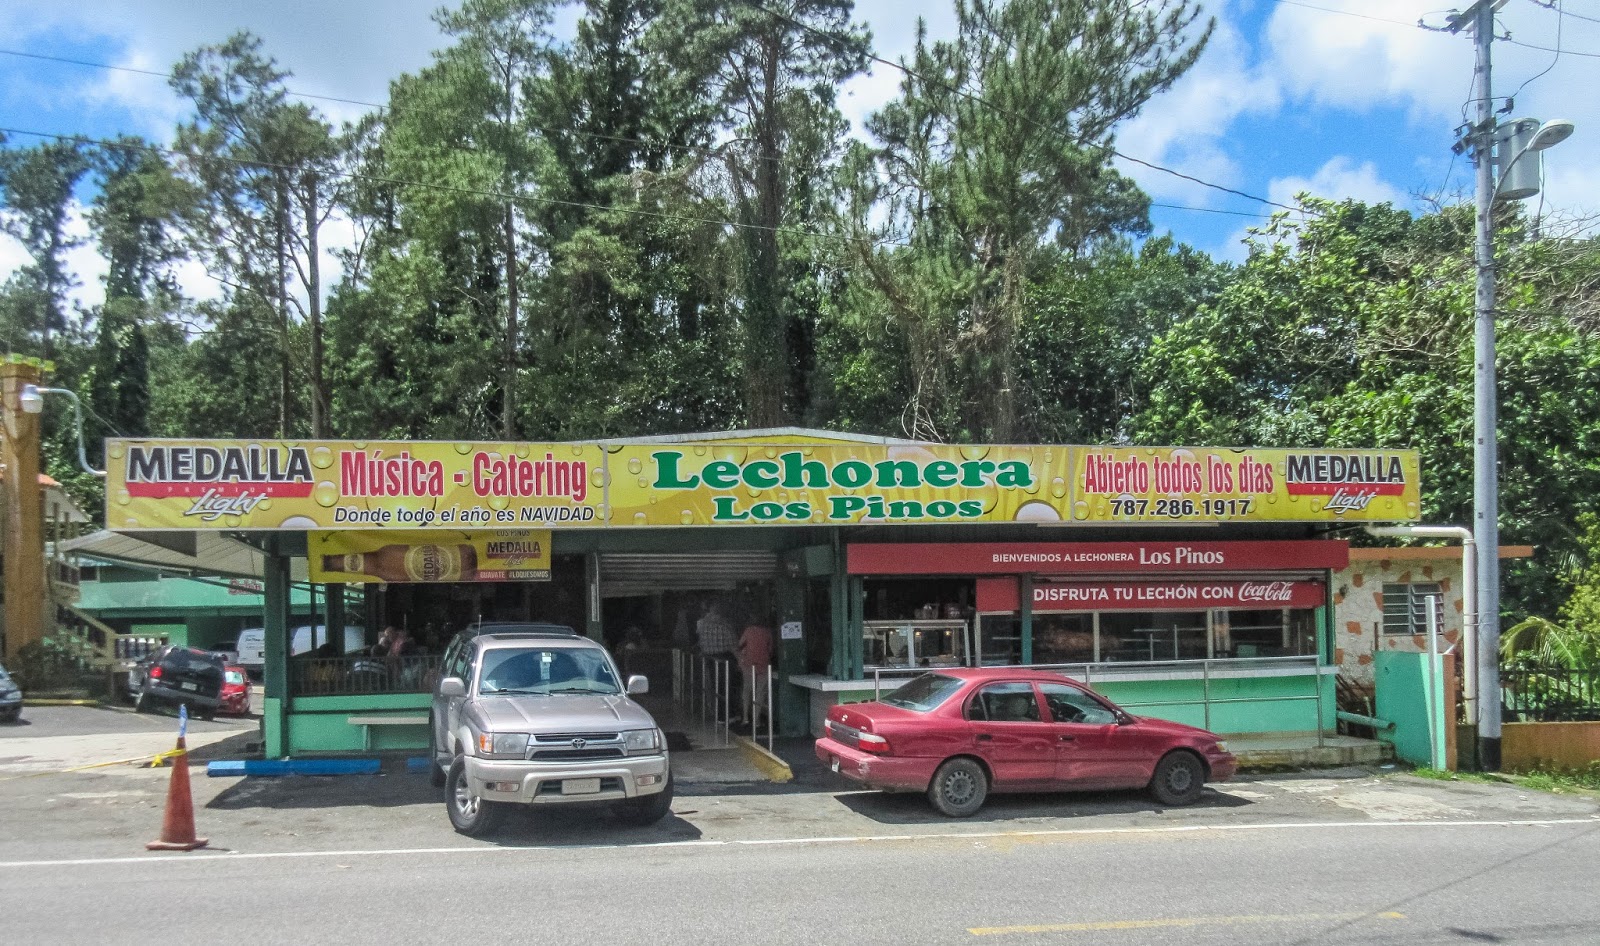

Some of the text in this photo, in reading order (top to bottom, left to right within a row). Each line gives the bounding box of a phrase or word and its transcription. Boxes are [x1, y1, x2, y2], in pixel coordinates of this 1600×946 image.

[127, 446, 315, 483] MEDALLA
[340, 450, 444, 497] Música
[473, 451, 588, 502] Catering
[651, 451, 1033, 489] Lechonera
[1085, 454, 1149, 494] Abierto
[1153, 456, 1202, 494] todos
[1207, 455, 1233, 493] los
[1287, 454, 1405, 483] MEDALLA
[167, 486, 274, 494] PREMIUM
[1322, 487, 1378, 514] Light
[183, 488, 269, 521] Light
[335, 506, 594, 523] Donde todo el año es NAVIDAD
[712, 496, 984, 520] Los Pinos
[1110, 499, 1251, 516] 787.286.1917
[487, 541, 541, 553] MEDALLA
[992, 547, 1225, 565] BIENVENIDOS A LECHONERA Los Pinos
[1033, 588, 1110, 601] DISFRUTA
[1114, 587, 1133, 600] TU
[1137, 584, 1198, 600] LECHÓN
[1201, 586, 1234, 599] CON
